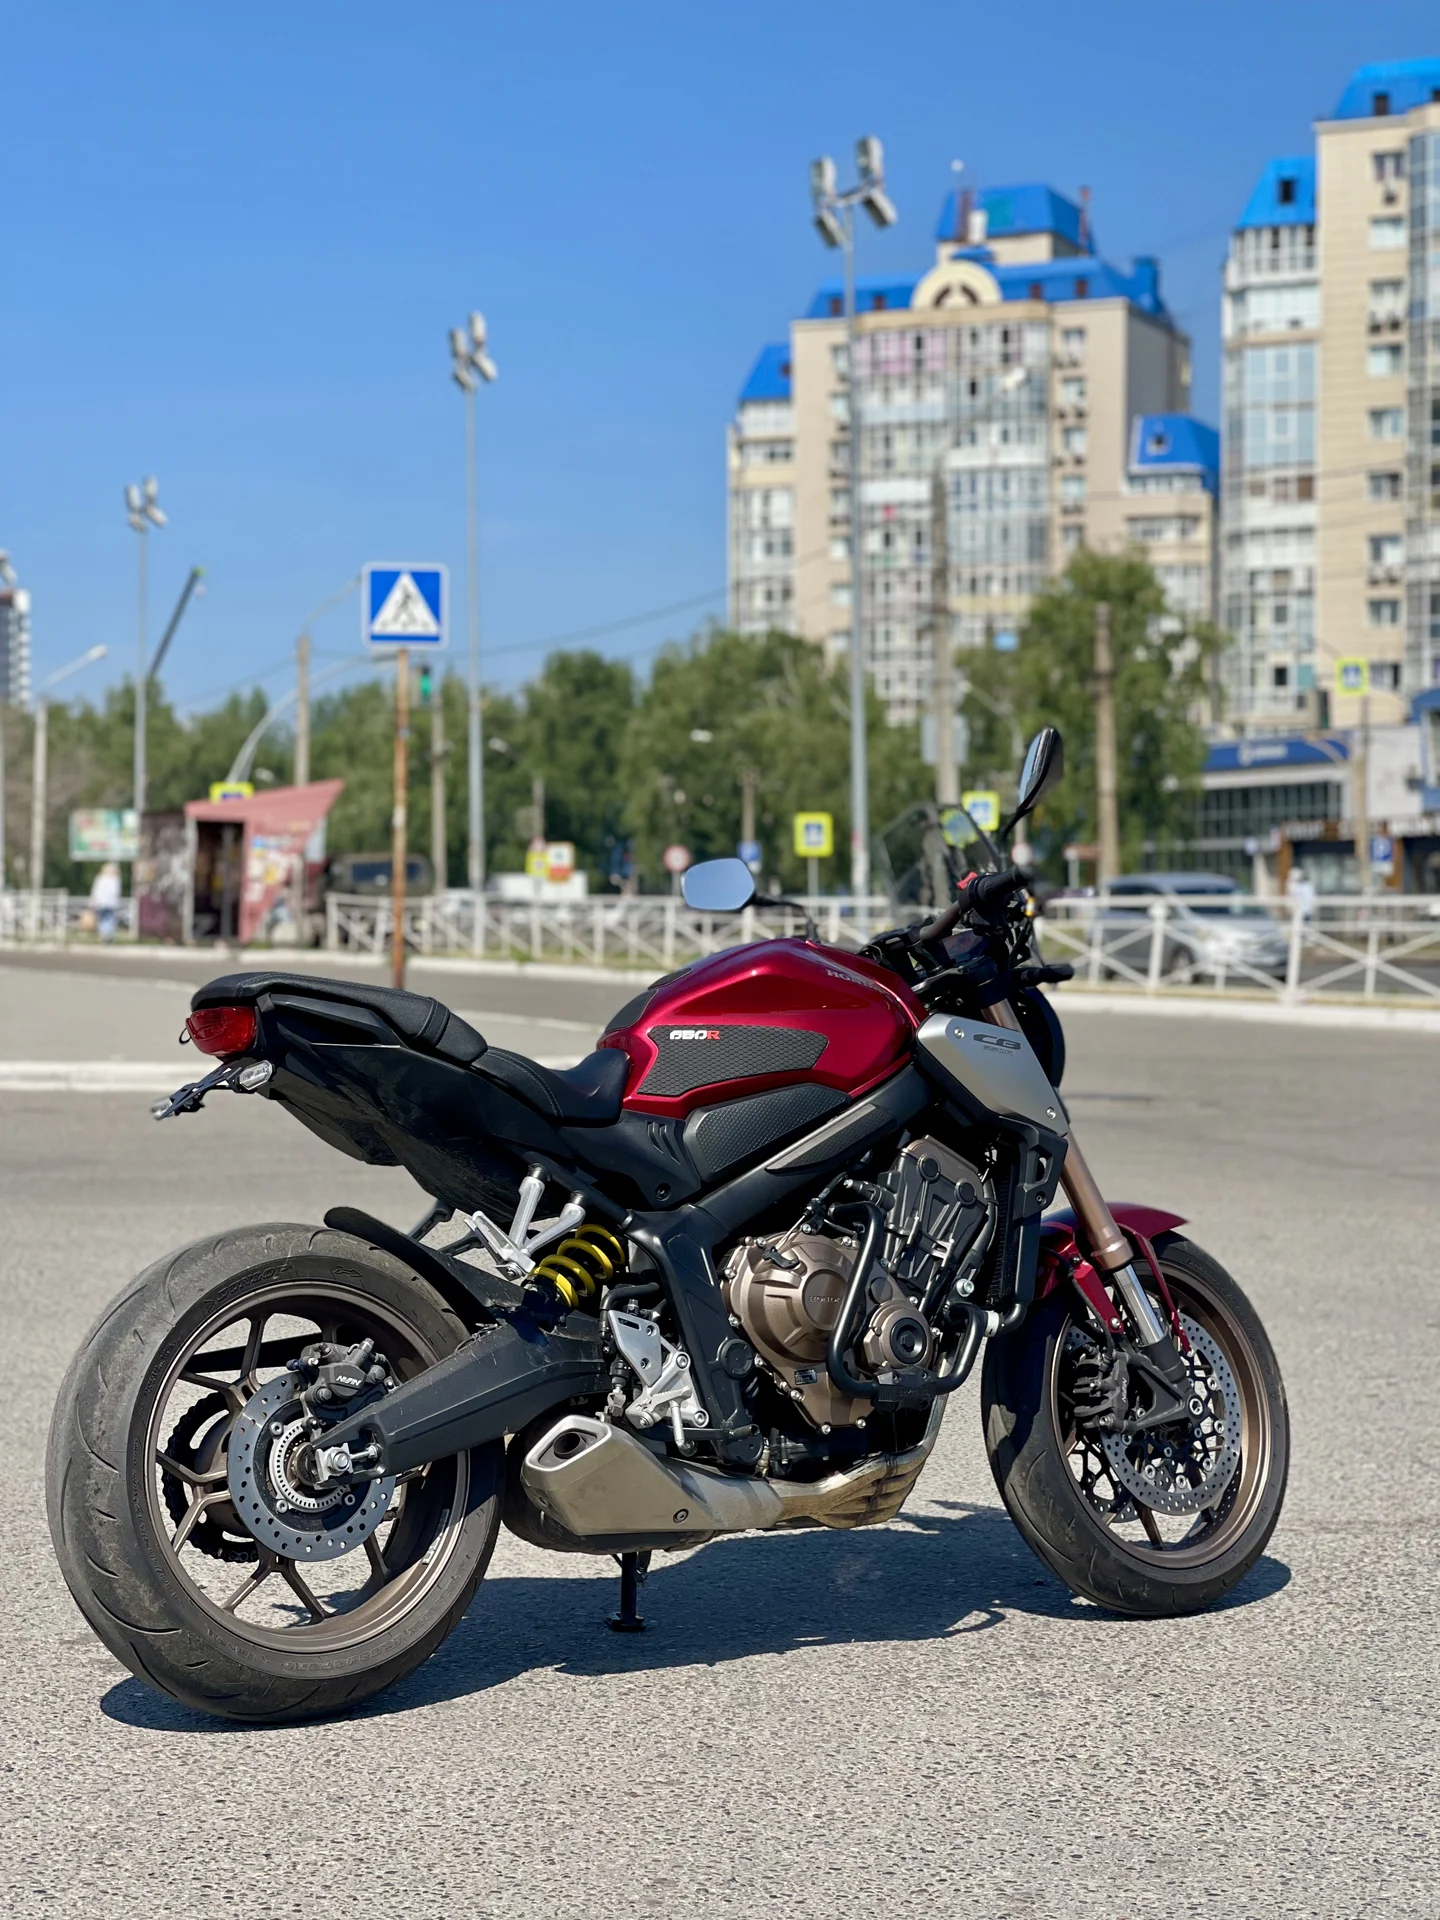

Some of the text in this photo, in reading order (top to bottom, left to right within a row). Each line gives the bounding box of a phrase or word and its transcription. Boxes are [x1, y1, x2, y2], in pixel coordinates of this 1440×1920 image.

[669, 1029, 720, 1041] 650R
[973, 1034, 1021, 1050] CB
[217, 1263, 293, 1299] DUNLOP
